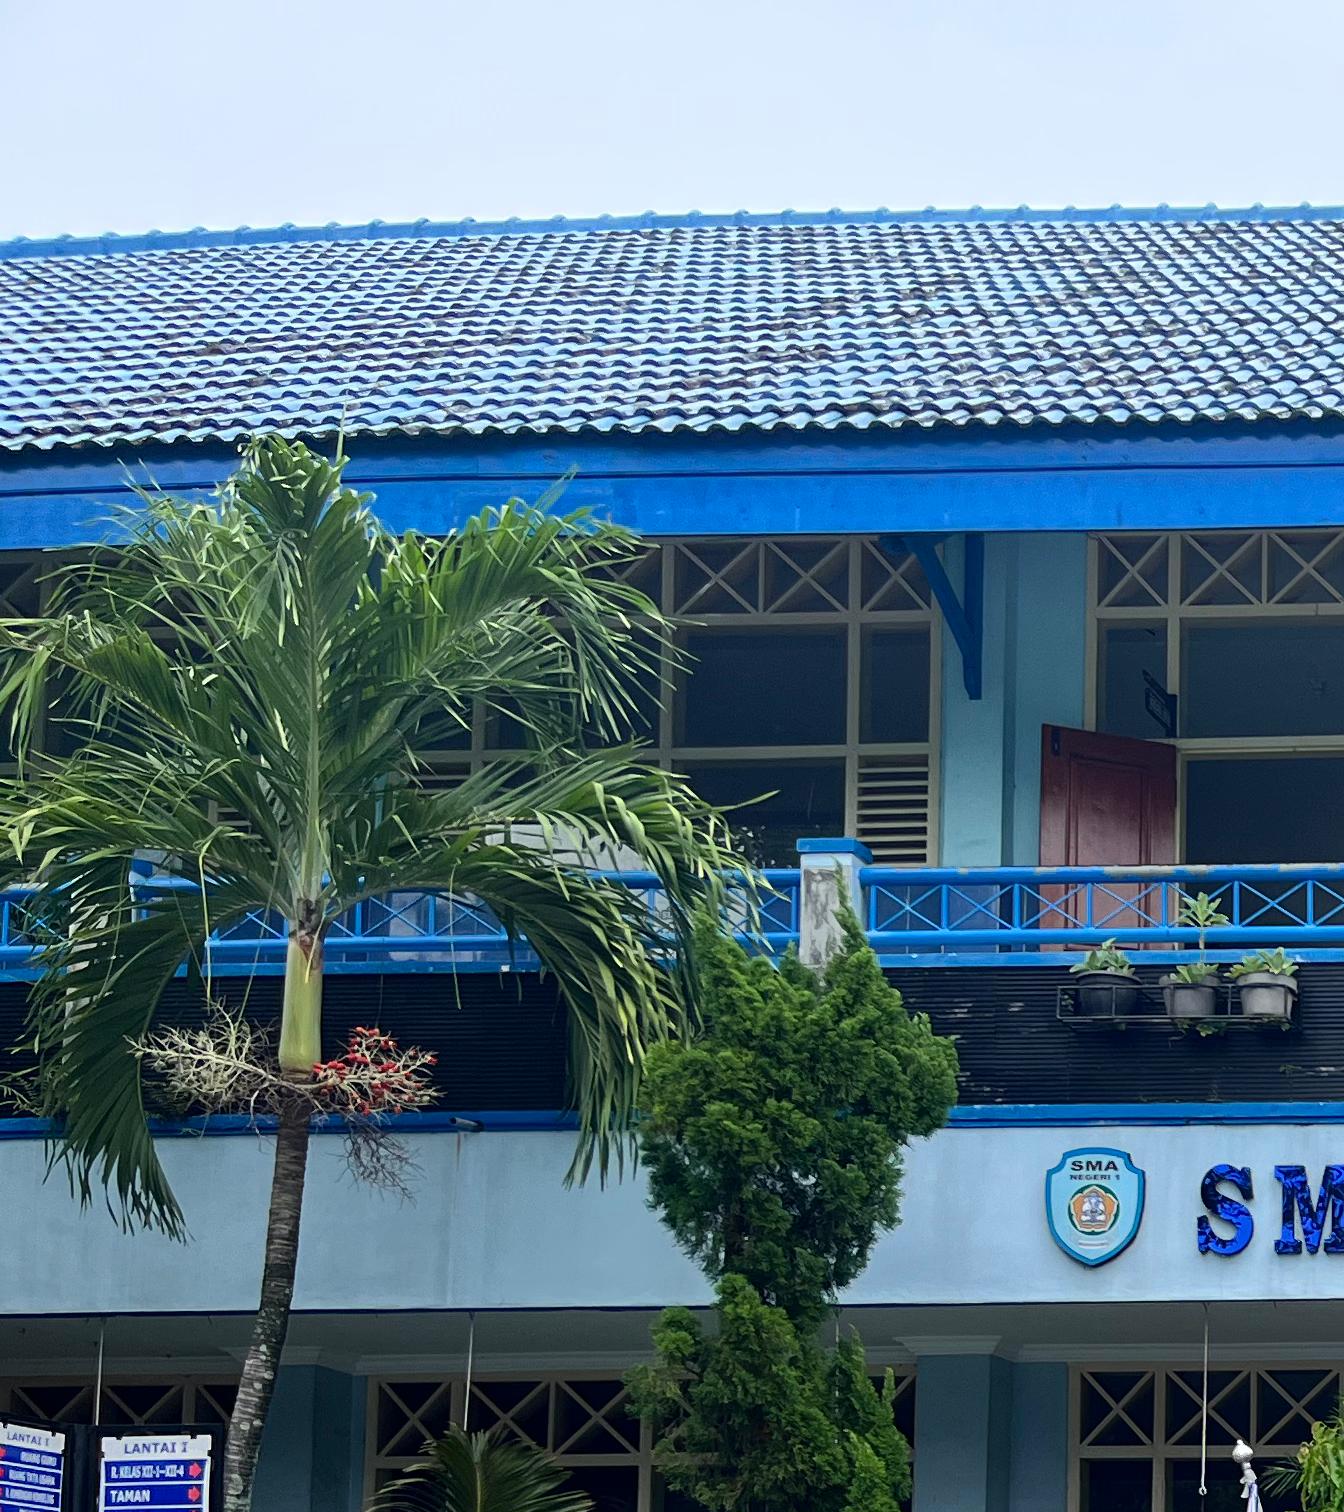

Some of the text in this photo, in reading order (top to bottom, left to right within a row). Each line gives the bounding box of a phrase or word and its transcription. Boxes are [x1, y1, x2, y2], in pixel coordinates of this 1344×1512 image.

[1070, 1160, 1118, 1172] SMA
[7, 1432, 42, 1446] LANTAI
[124, 1441, 189, 1455] LANTAI I
[110, 1489, 151, 1503] TAMAN
